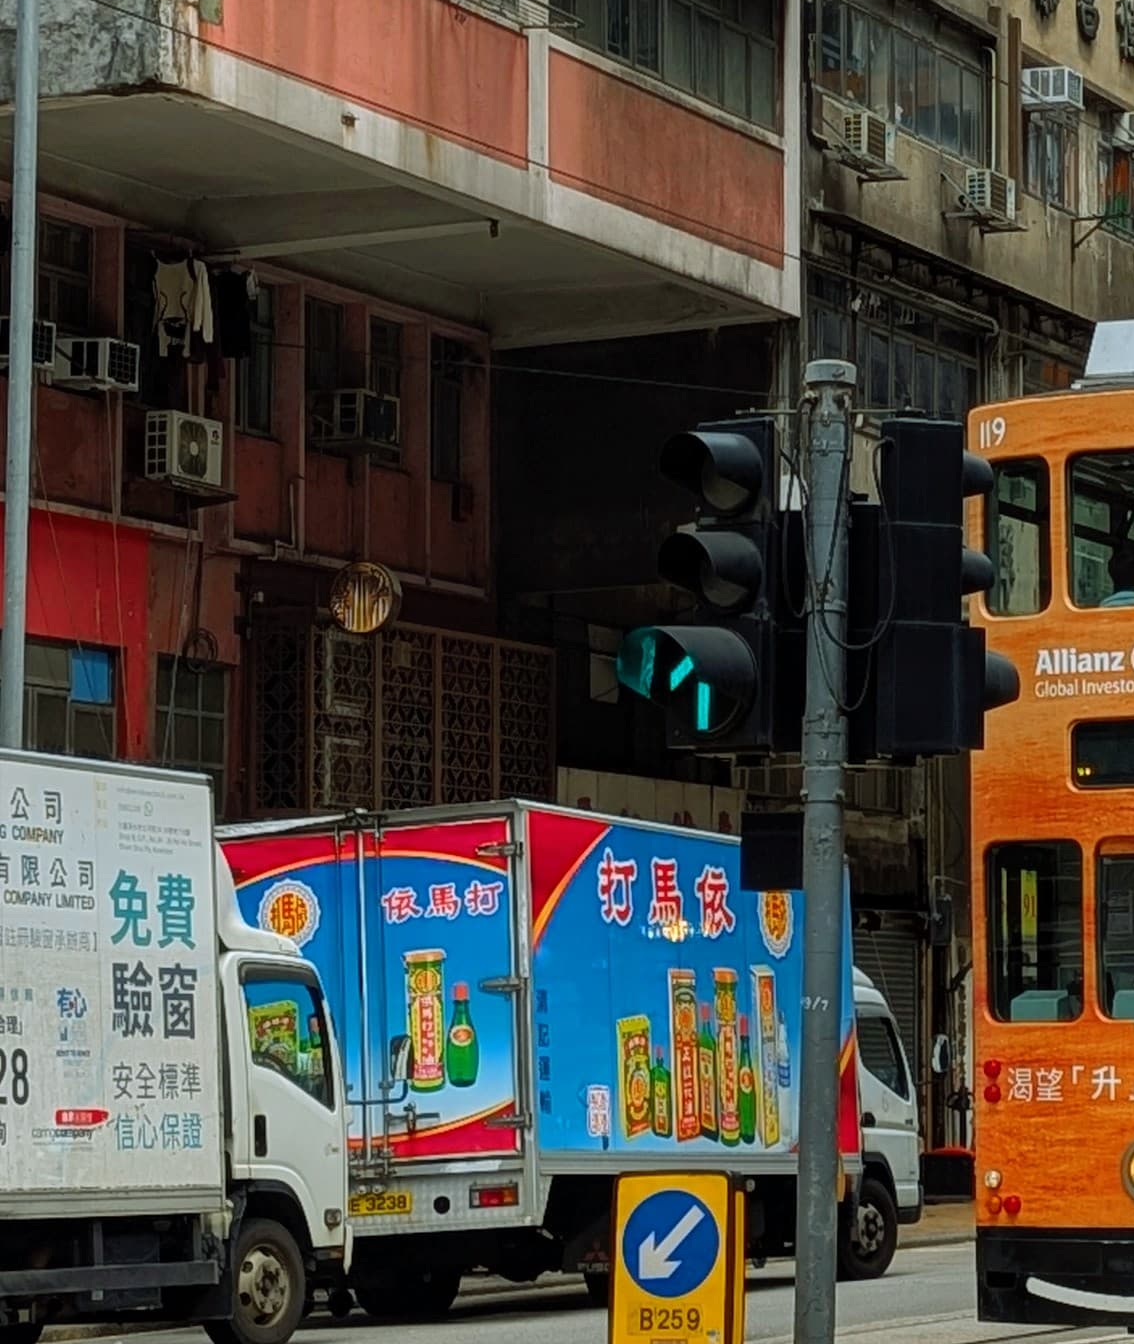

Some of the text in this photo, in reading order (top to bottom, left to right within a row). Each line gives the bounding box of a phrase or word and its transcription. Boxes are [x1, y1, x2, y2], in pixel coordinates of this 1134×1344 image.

[980, 417, 1006, 449] 119
[1035, 647, 1125, 677] Allianz
[1035, 678, 1079, 698] Global
[11, 786, 62, 825] 公司
[12, 825, 65, 845] COMPANY
[4, 889, 95, 911] COMPANY LIMITED
[109, 868, 196, 951] 免費
[112, 1060, 202, 1101] 安全標準
[114, 1112, 203, 1152] 信心保證
[365, 1194, 408, 1212] 3238
